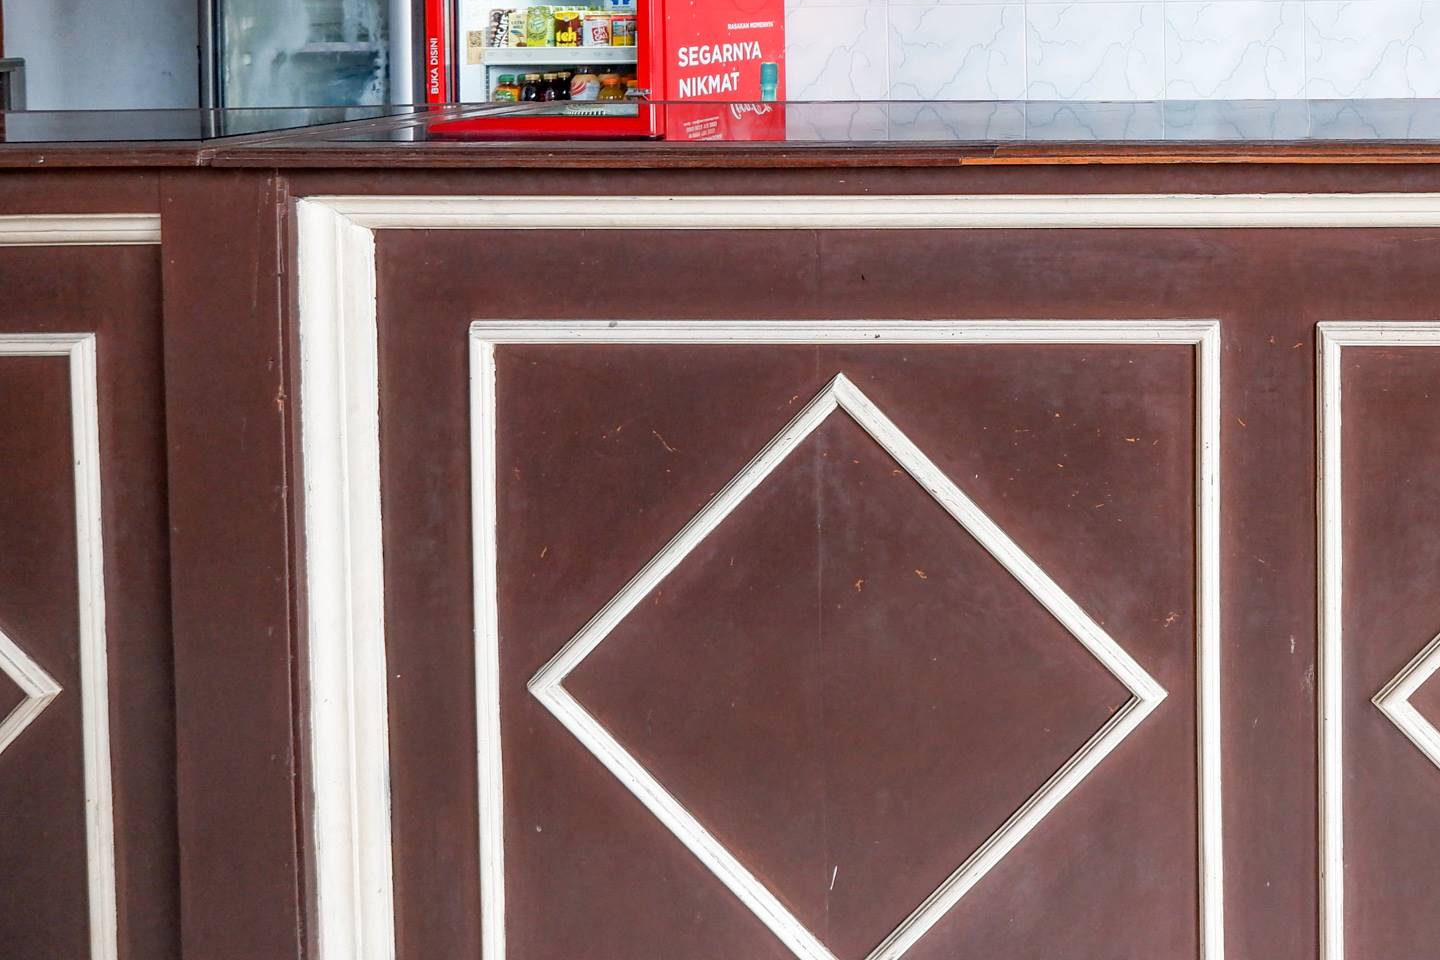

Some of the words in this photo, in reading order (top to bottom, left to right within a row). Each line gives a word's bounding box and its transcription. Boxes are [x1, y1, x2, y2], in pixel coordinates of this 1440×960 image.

[556, 26, 577, 42] teh
[430, 37, 439, 66] DISINI
[678, 41, 762, 67] SEGARNYA
[430, 67, 440, 95] BUKA
[679, 71, 740, 99] NIKMAT
